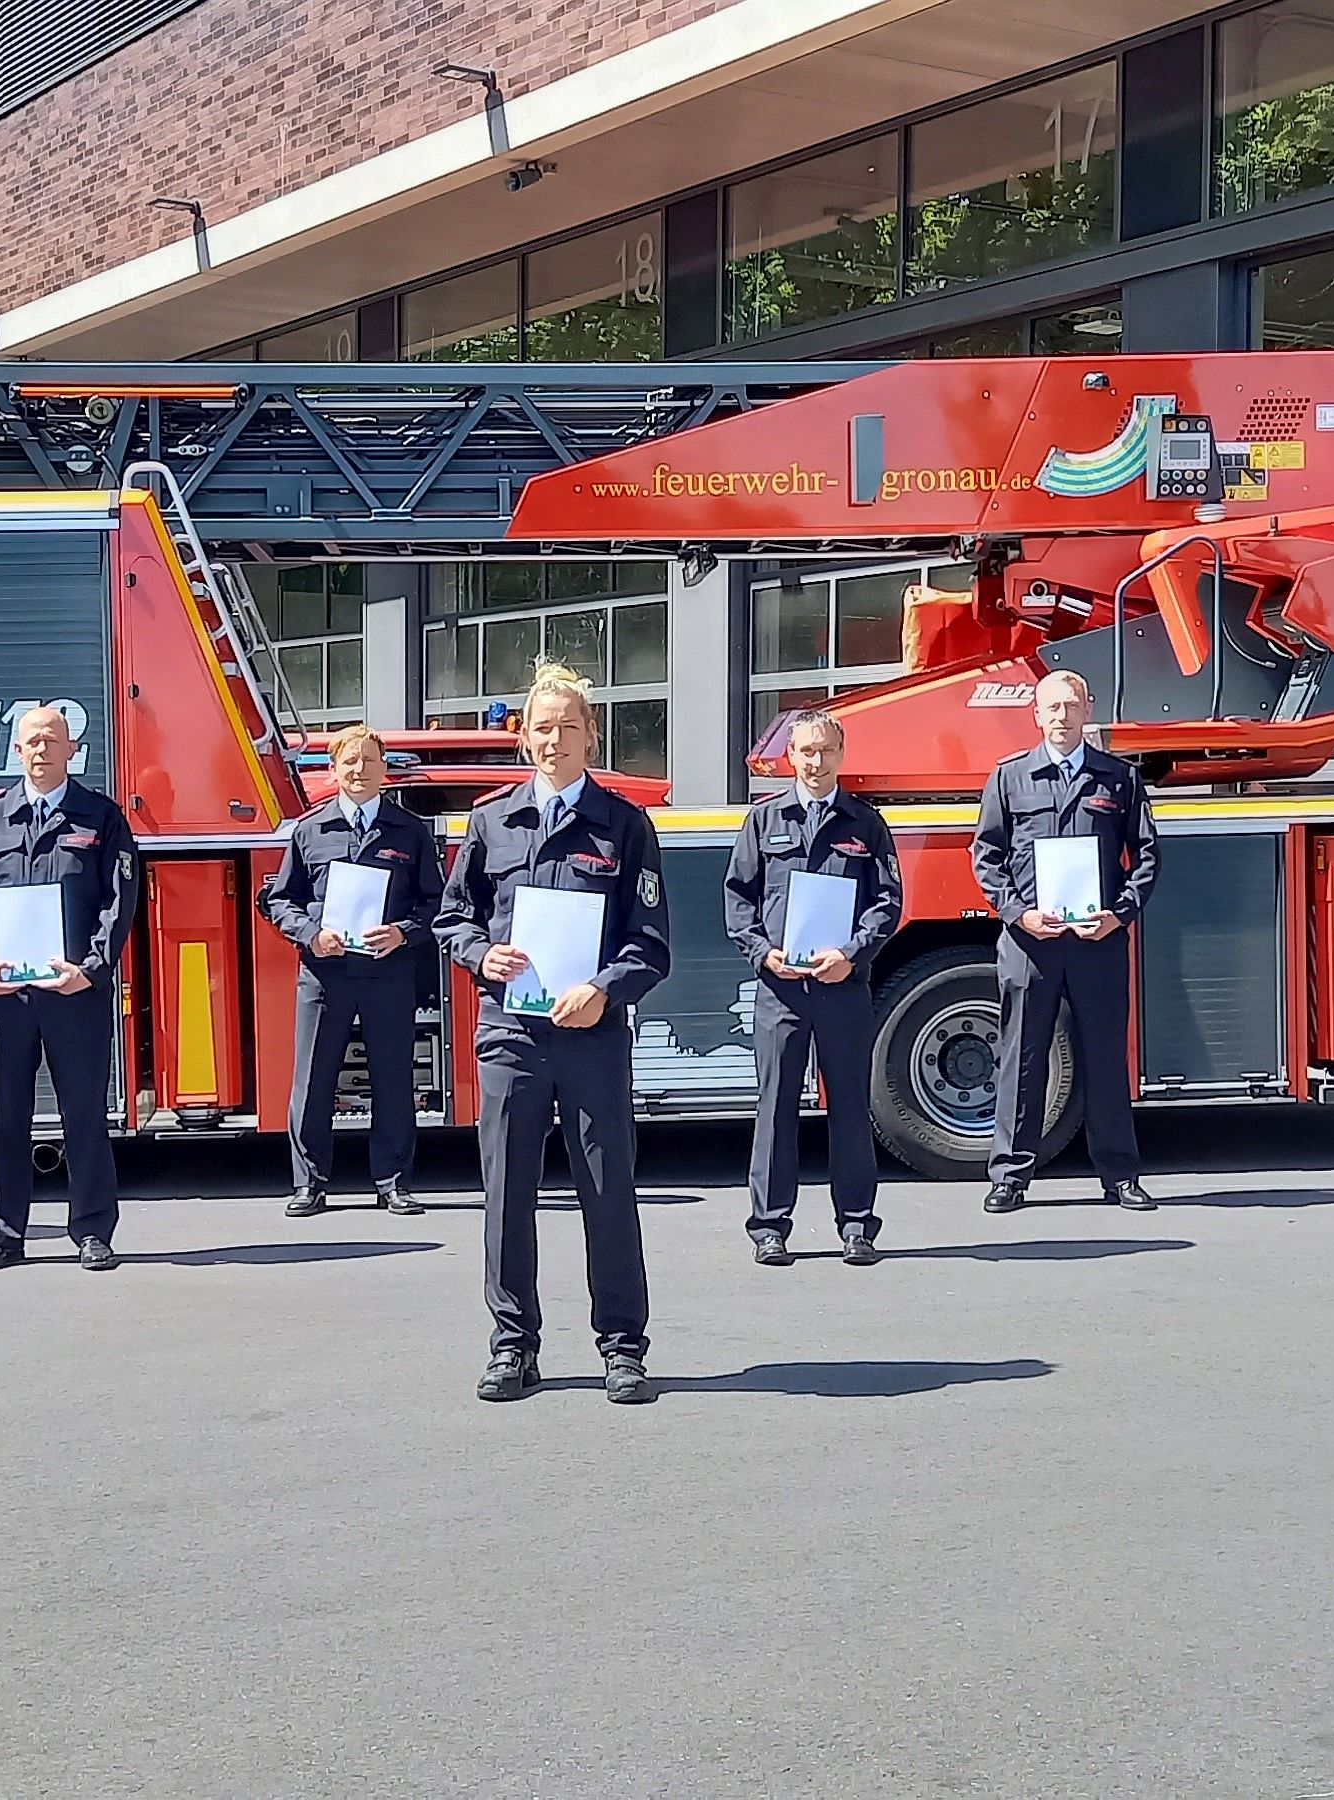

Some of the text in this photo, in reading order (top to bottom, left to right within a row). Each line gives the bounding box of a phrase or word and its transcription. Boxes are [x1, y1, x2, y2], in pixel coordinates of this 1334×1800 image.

[1043, 96, 1102, 182] 17
[615, 232, 655, 307] 18
[881, 467, 1033, 501] gronau.de
[968, 682, 1036, 704] Metz
